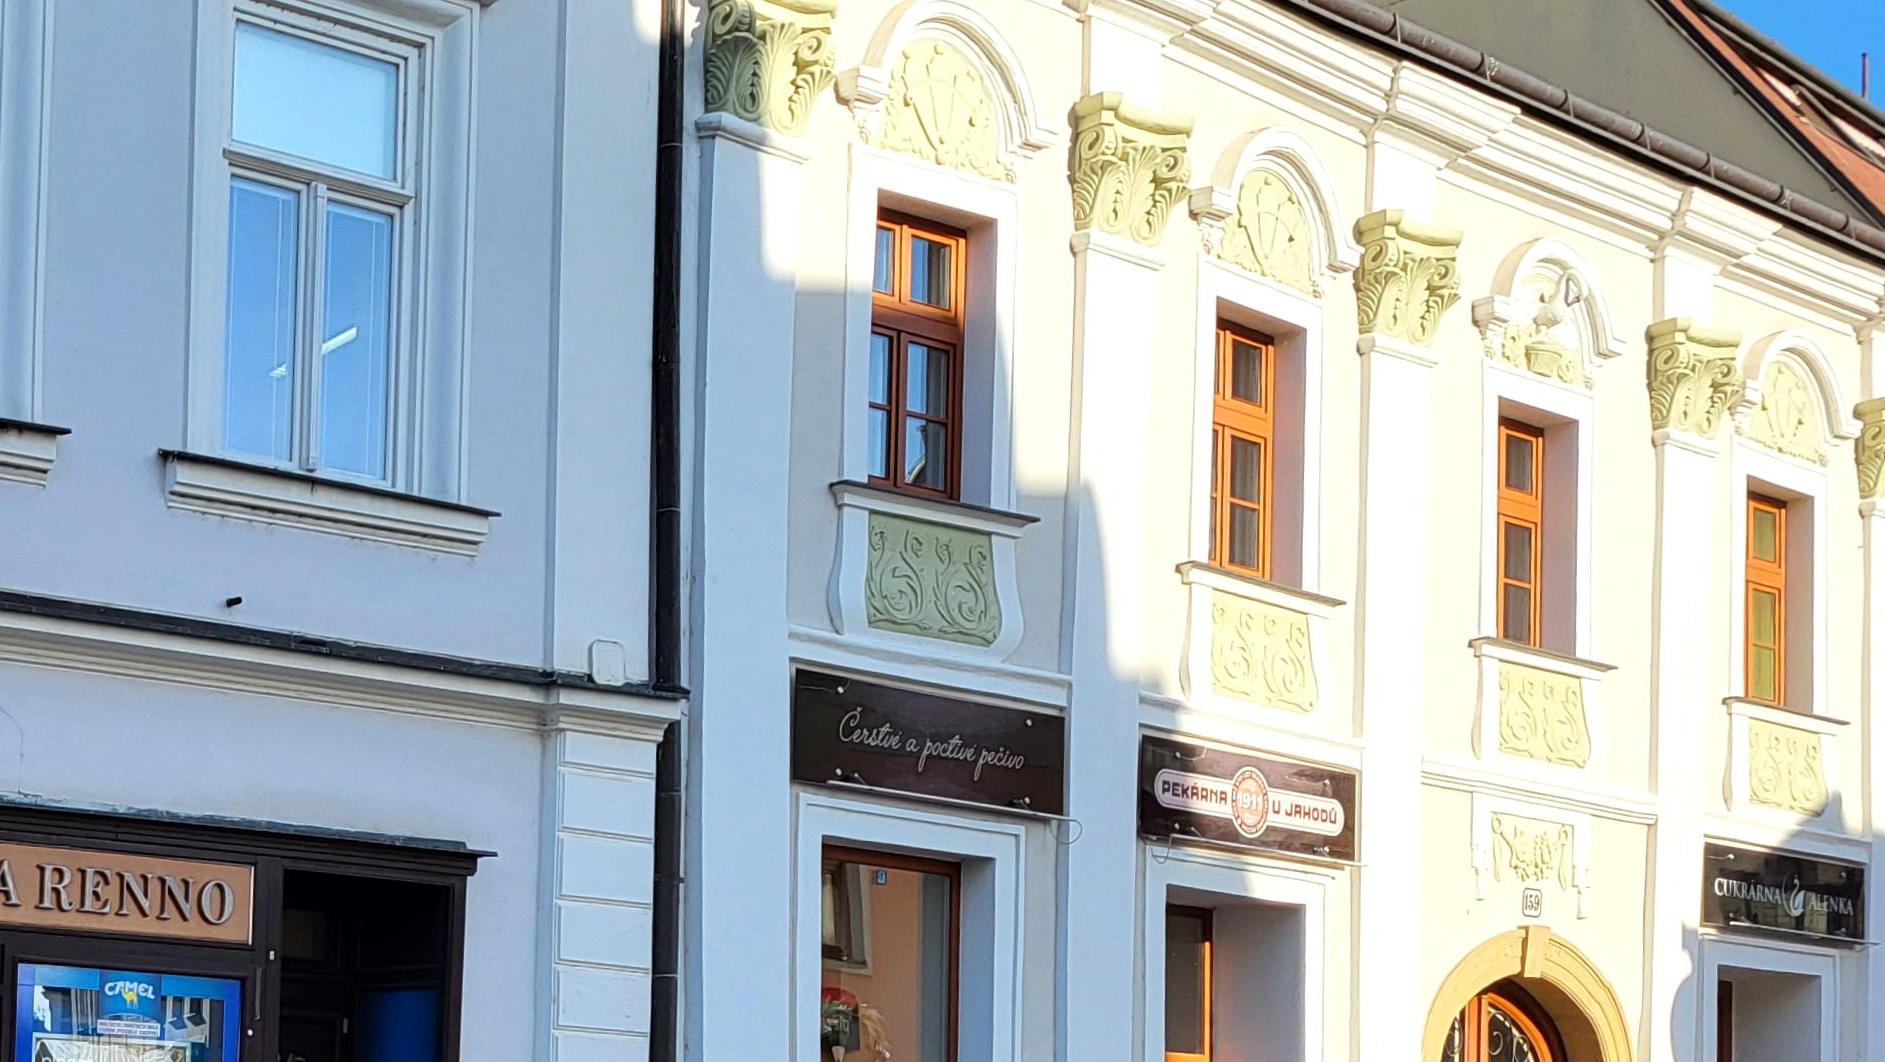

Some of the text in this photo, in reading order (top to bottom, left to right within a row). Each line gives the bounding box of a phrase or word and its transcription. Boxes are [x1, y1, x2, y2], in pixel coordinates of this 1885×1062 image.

[840, 706, 1024, 781] Čerstvé a poctivé pečivo
[1162, 780, 1228, 806] PEKÁRNA
[1237, 792, 1263, 811] 1911
[1272, 800, 1281, 814] U
[35, 863, 235, 925] RENNO
[1525, 893, 1540, 911] 159
[1714, 877, 1854, 916] CUKRÁRNA ALENKA
[104, 981, 156, 999] CAMEL
